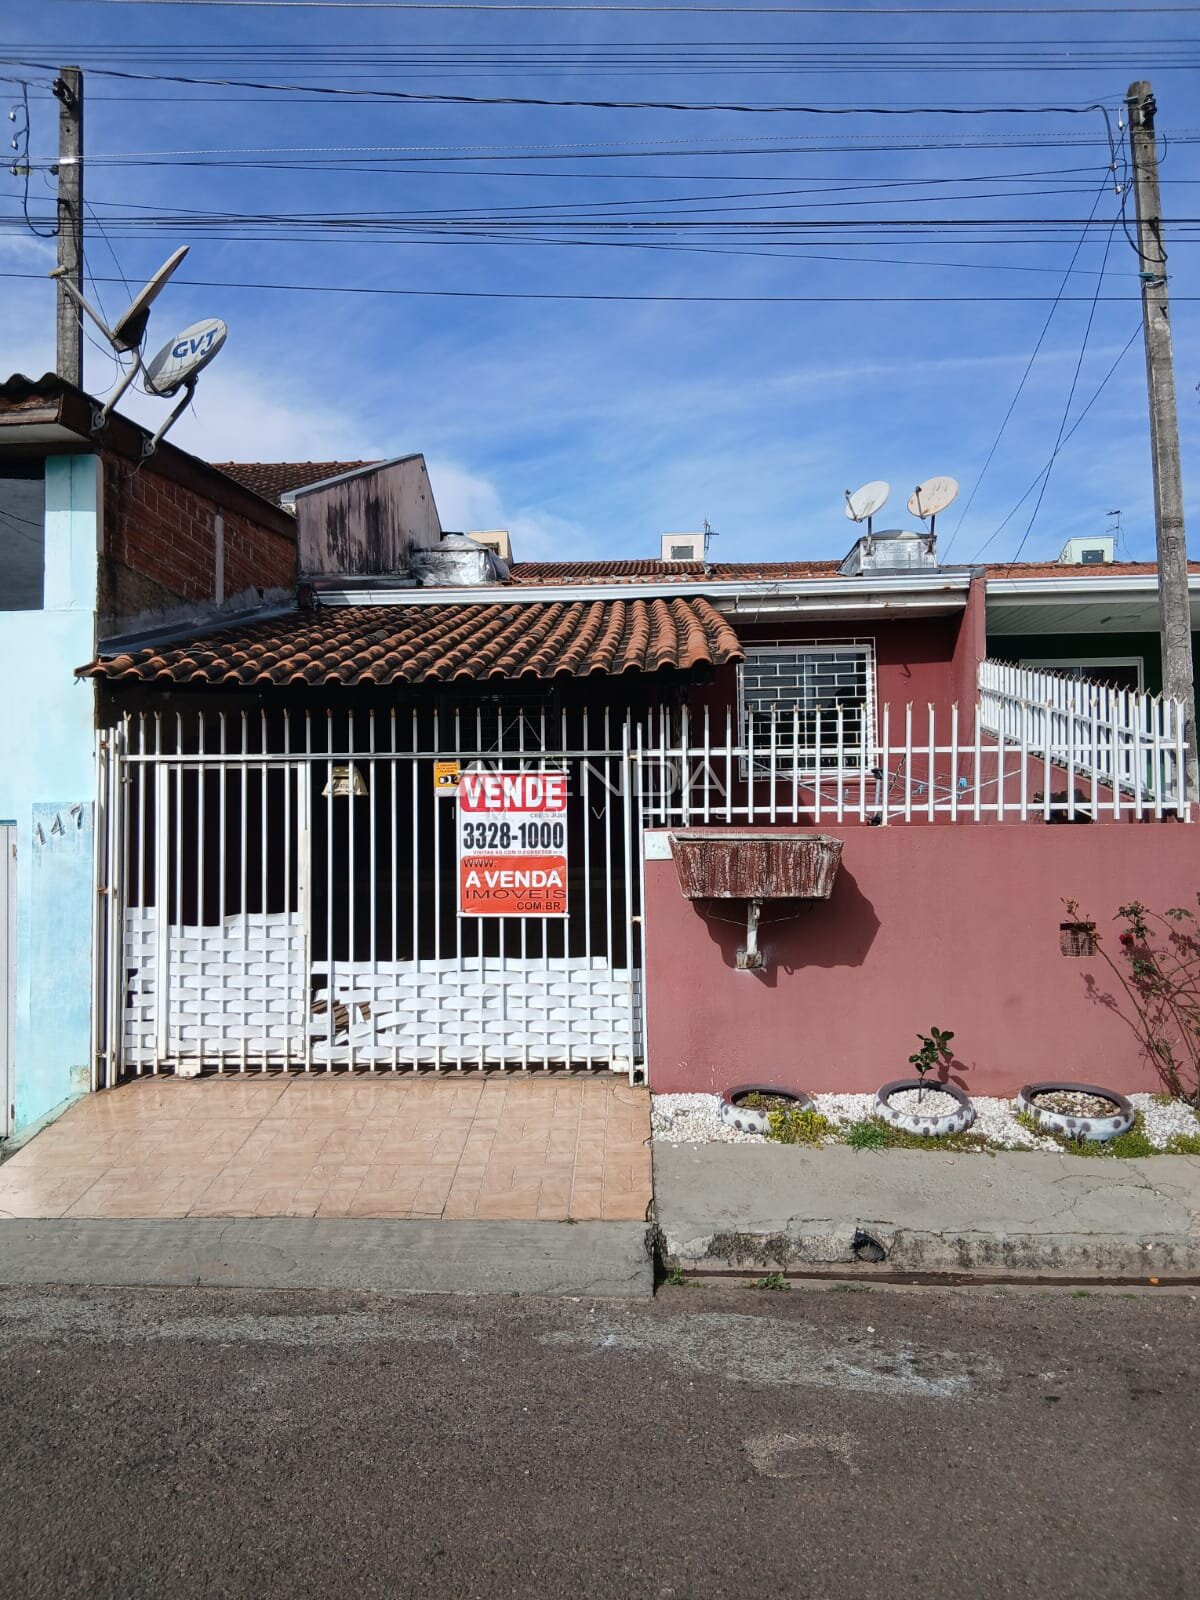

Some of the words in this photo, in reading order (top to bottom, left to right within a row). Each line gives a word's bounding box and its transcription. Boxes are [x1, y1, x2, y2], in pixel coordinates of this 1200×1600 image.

[172, 328, 218, 358] GVT
[463, 777, 563, 808] VENDE
[35, 803, 84, 845] 147
[463, 822, 564, 849] 3328-1000
